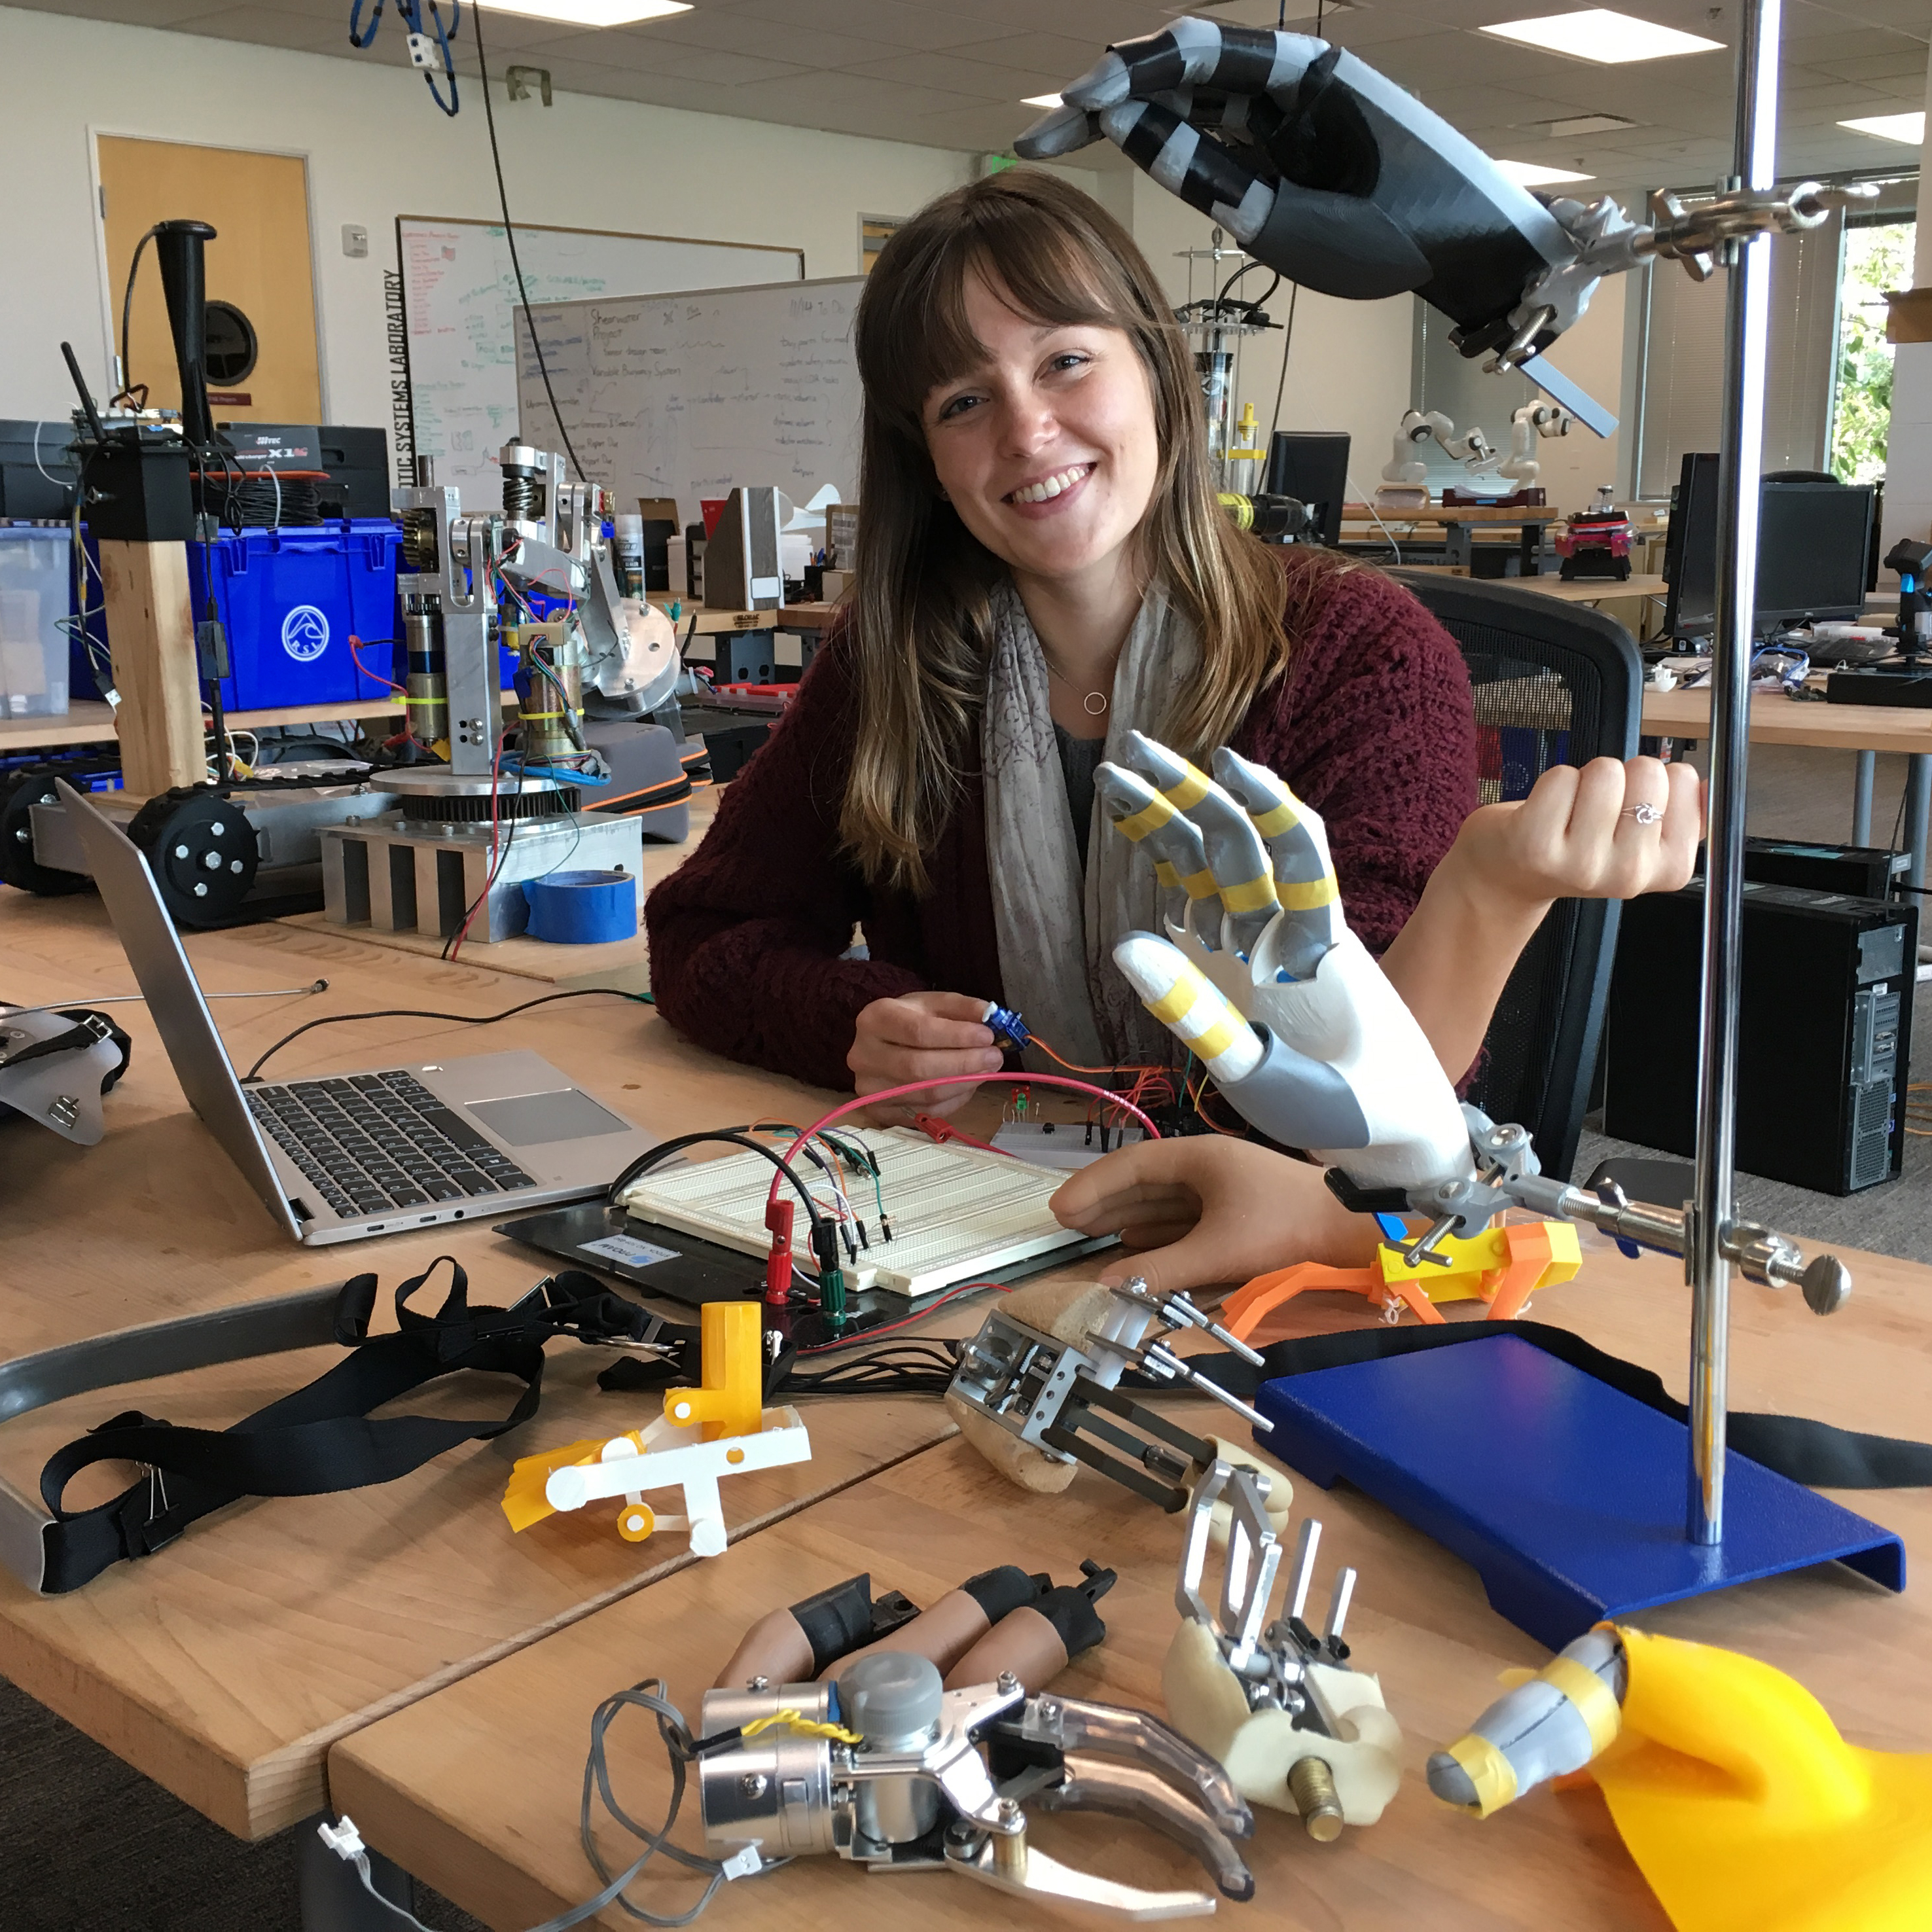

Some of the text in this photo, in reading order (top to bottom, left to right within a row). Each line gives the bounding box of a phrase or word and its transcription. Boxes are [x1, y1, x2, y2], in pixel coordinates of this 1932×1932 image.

[383, 269, 407, 374] LABORATORY
[590, 308, 641, 325] Shearwater
[592, 326, 622, 347] Project
[391, 380, 412, 452] SYSTEMS
[291, 639, 321, 654] RSL
[1103, 1090, 1130, 1107] MODEL
